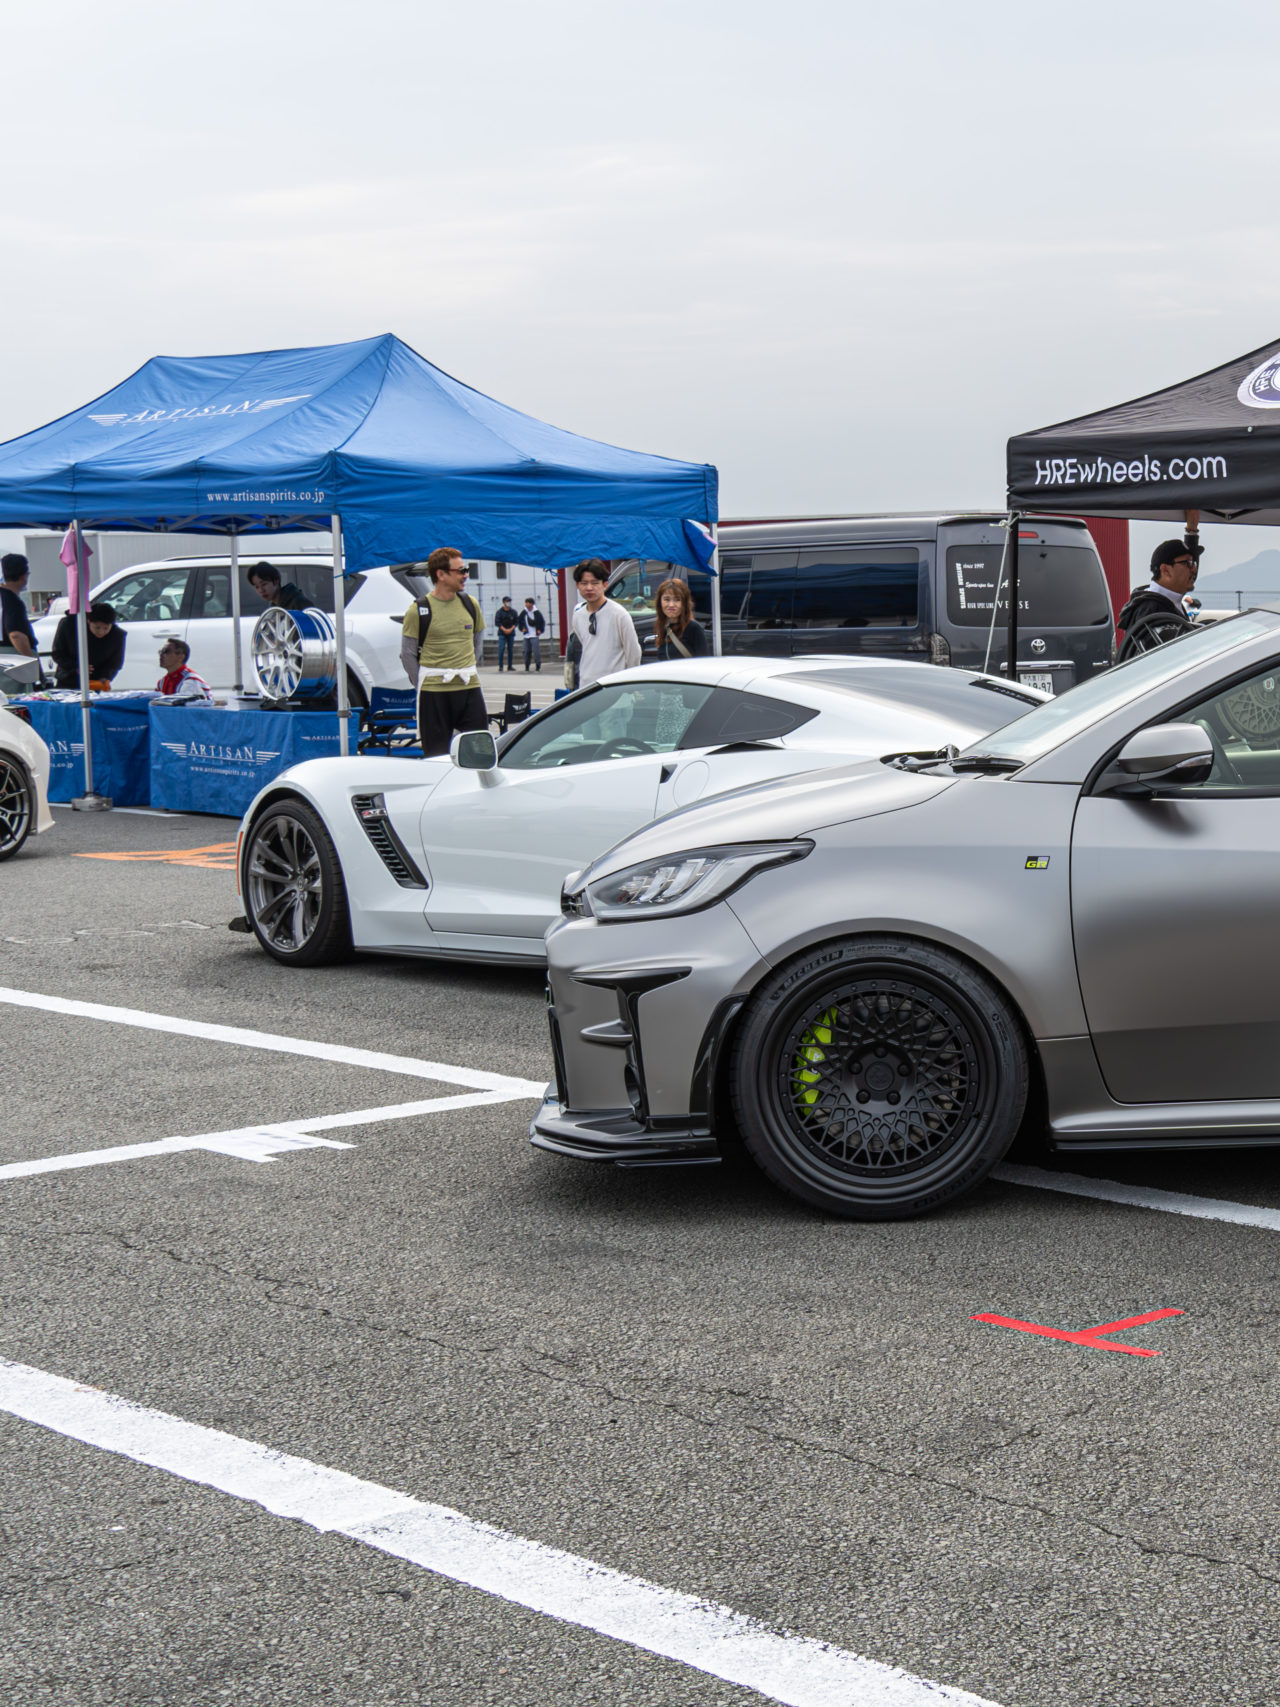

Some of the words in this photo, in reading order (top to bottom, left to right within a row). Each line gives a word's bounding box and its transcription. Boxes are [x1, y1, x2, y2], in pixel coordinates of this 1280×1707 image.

[121, 399, 262, 424] ARTISAN
[1034, 454, 1228, 486] HREwheels.com
[206, 488, 326, 504] www.artisanspirits.co.jp
[997, 600, 1030, 609] VESE
[190, 741, 254, 760] ARTISAN
[783, 950, 842, 988] MICHELIN
